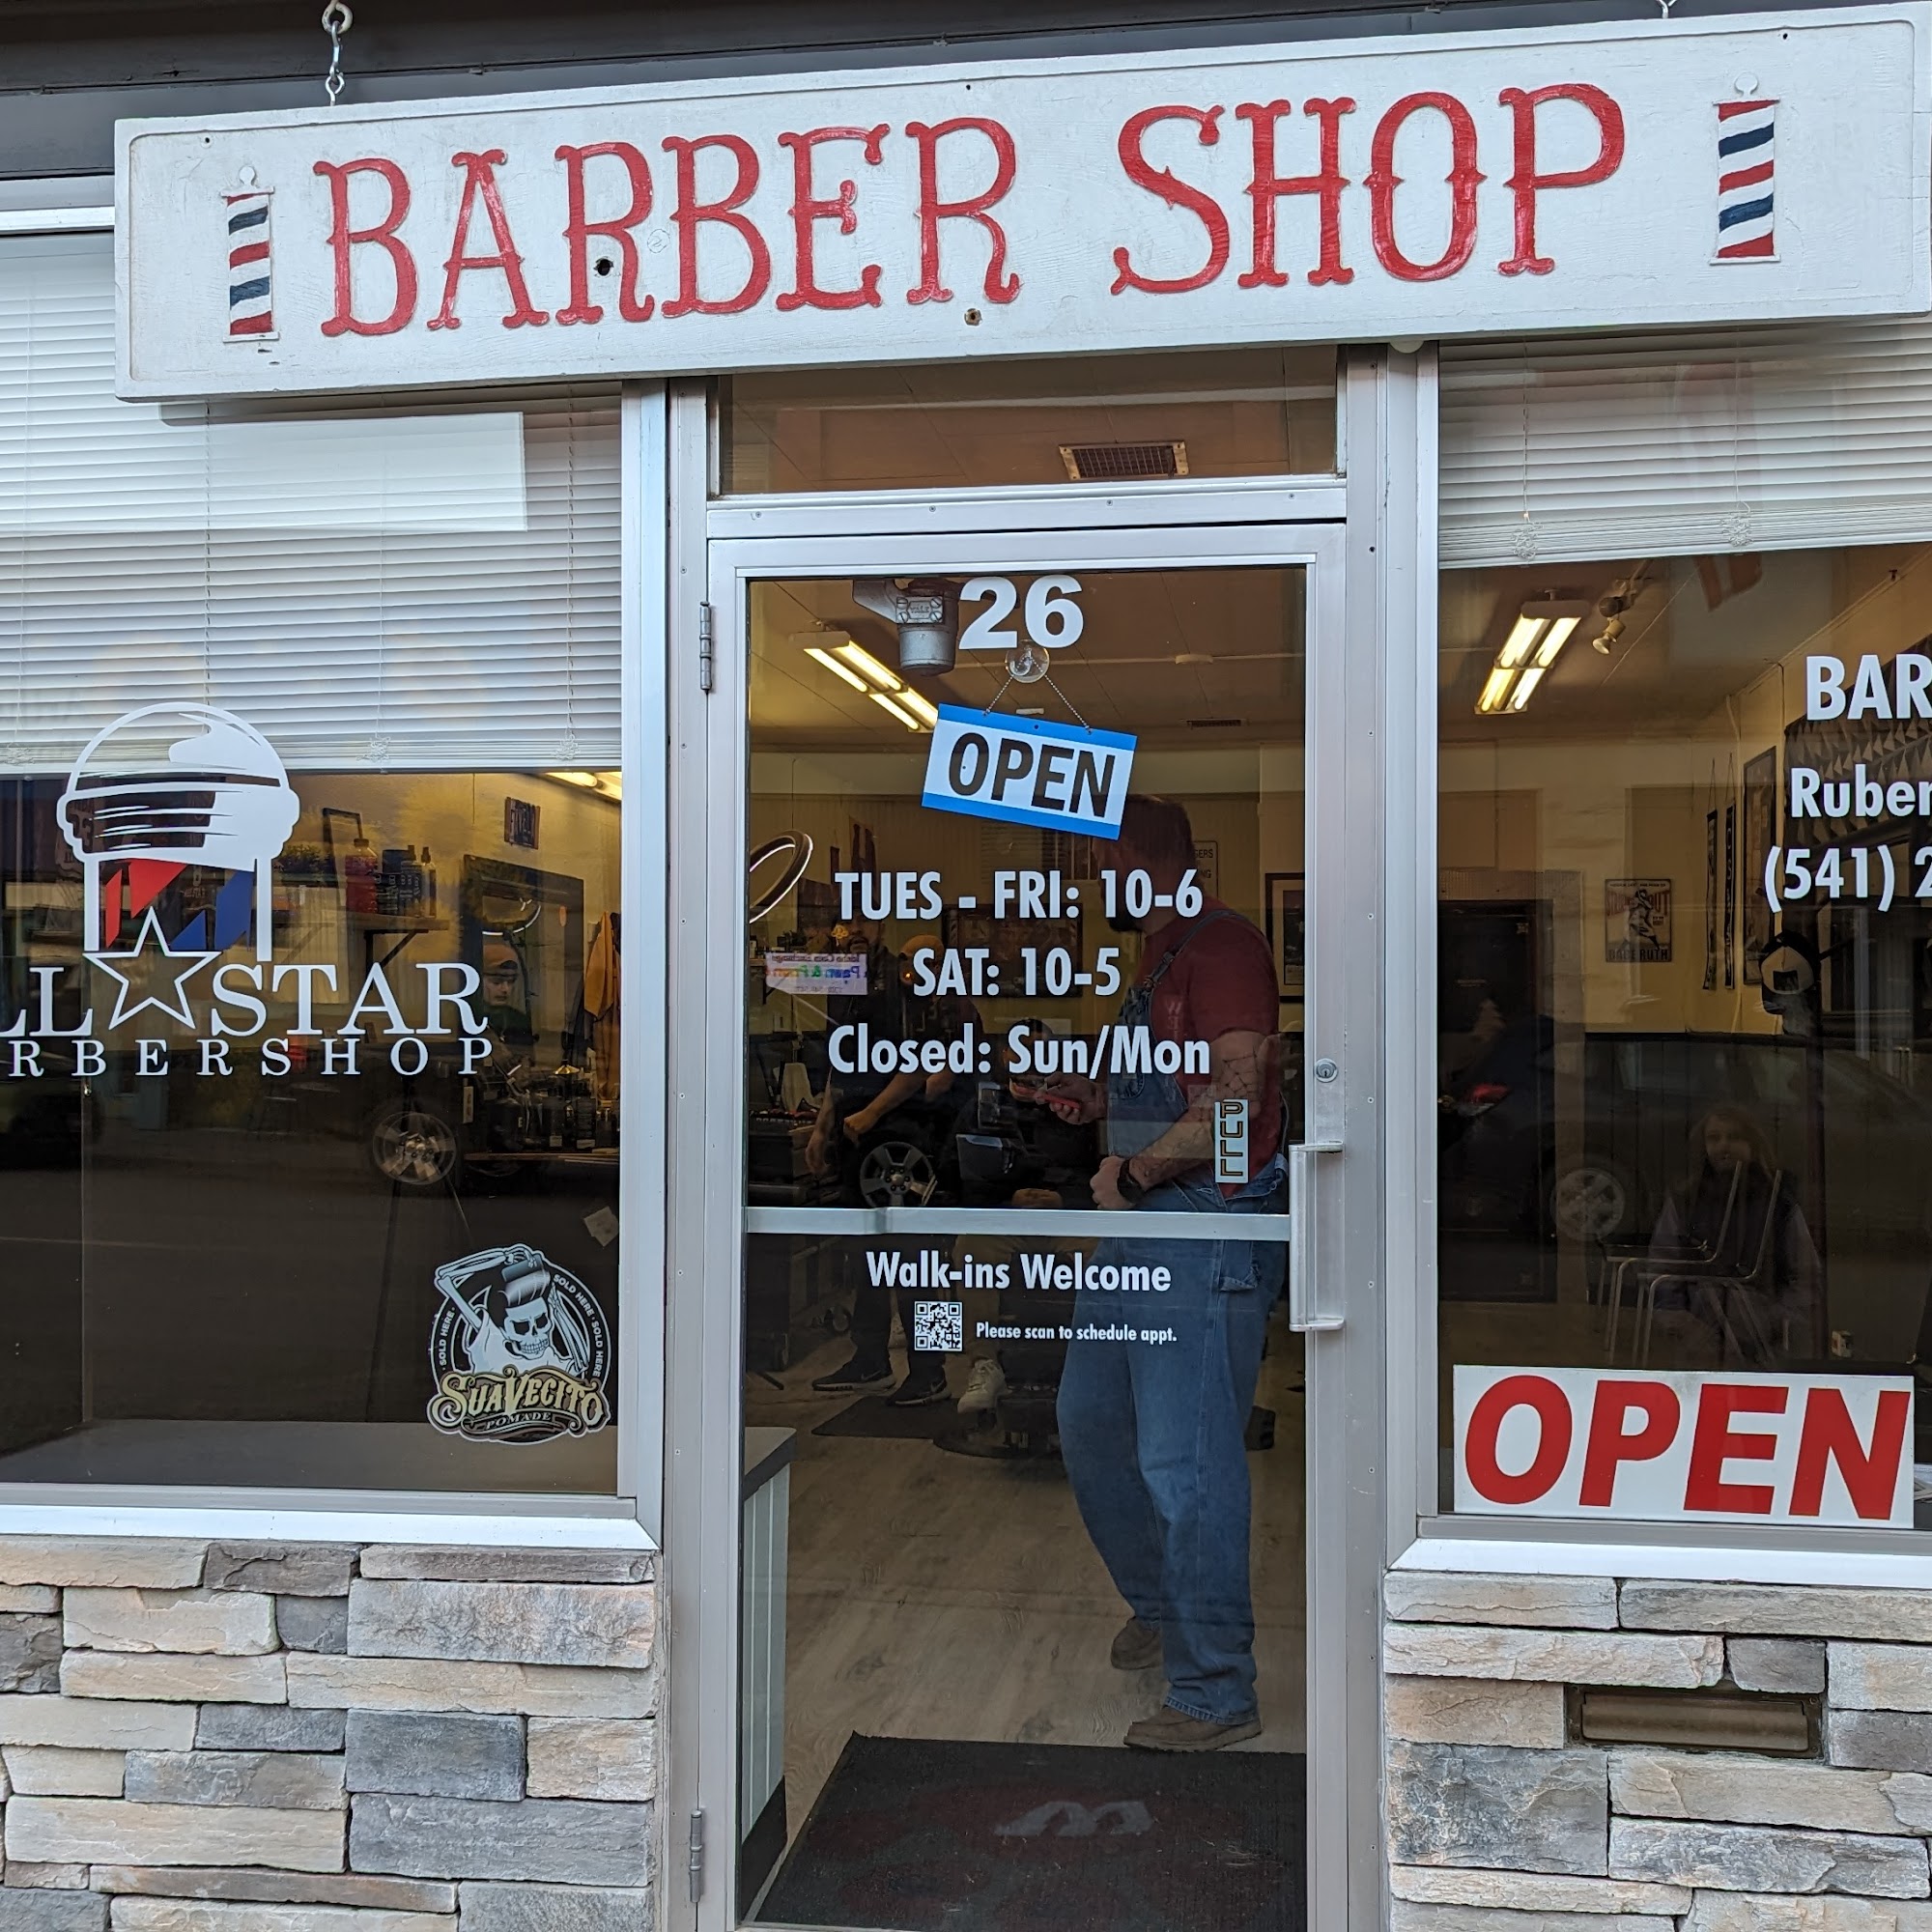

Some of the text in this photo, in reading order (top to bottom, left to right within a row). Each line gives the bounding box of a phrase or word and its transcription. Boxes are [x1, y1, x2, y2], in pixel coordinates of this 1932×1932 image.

[315, 83, 1625, 336] BARBER SHOP
[958, 574, 1084, 650] 26
[1805, 653, 1932, 721] BAR
[949, 732, 1116, 818] OPEN
[835, 870, 943, 920] TUES
[994, 870, 1079, 919] FRI:
[1100, 868, 1203, 919] 10-6
[1764, 844, 1895, 913] (541)
[211, 962, 488, 1037] STAR
[913, 947, 1121, 997] SAT: 10-5
[8, 1037, 493, 1077] RBERSHOP
[828, 1022, 1210, 1080] Closed: Sun/Mon
[1220, 1101, 1243, 1177] PULL
[553, 1273, 595, 1318] SOLD HERE
[866, 1249, 1172, 1292] Walk-ins Welcome
[438, 1309, 456, 1367] SOLD HERE
[591, 1319, 605, 1378] SOLD HERE
[976, 1321, 1178, 1346] Please scan to schedule appt.
[432, 1367, 605, 1428] SUAVECITO
[485, 1411, 553, 1430] POMADE
[1465, 1375, 1911, 1520] OPEN
